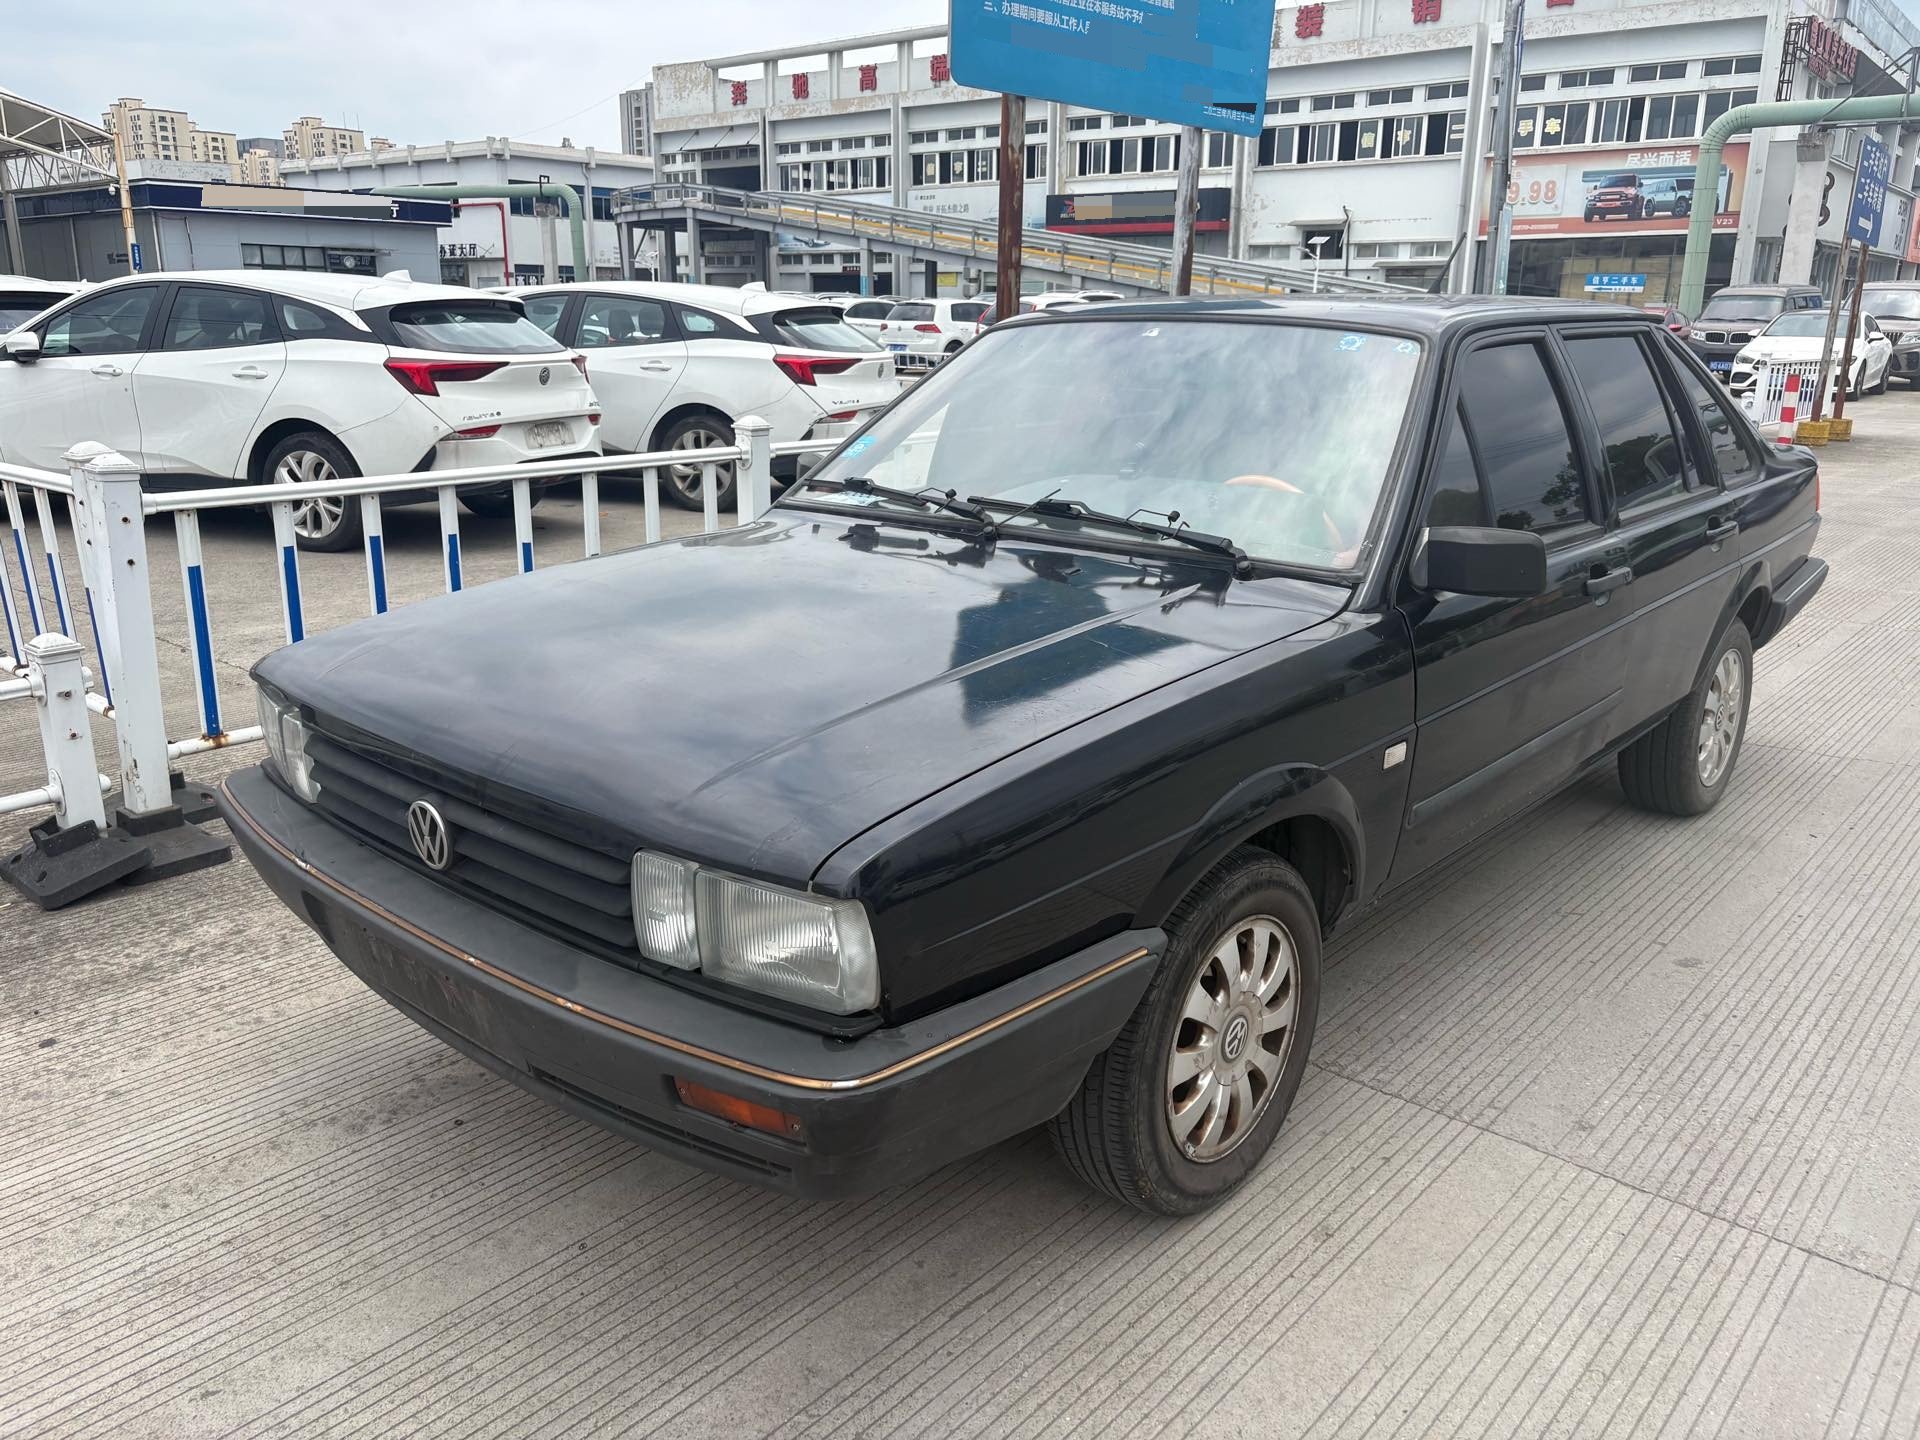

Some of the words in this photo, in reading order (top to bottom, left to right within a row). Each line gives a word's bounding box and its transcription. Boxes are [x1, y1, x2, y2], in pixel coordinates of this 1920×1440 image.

[731, 54, 950, 106] 奔驰高端
[1624, 150, 1693, 168] 尽兴而活
[1506, 179, 1557, 205] 9.98
[1716, 218, 1734, 226] V23
[440, 243, 477, 258] 办证大厅
